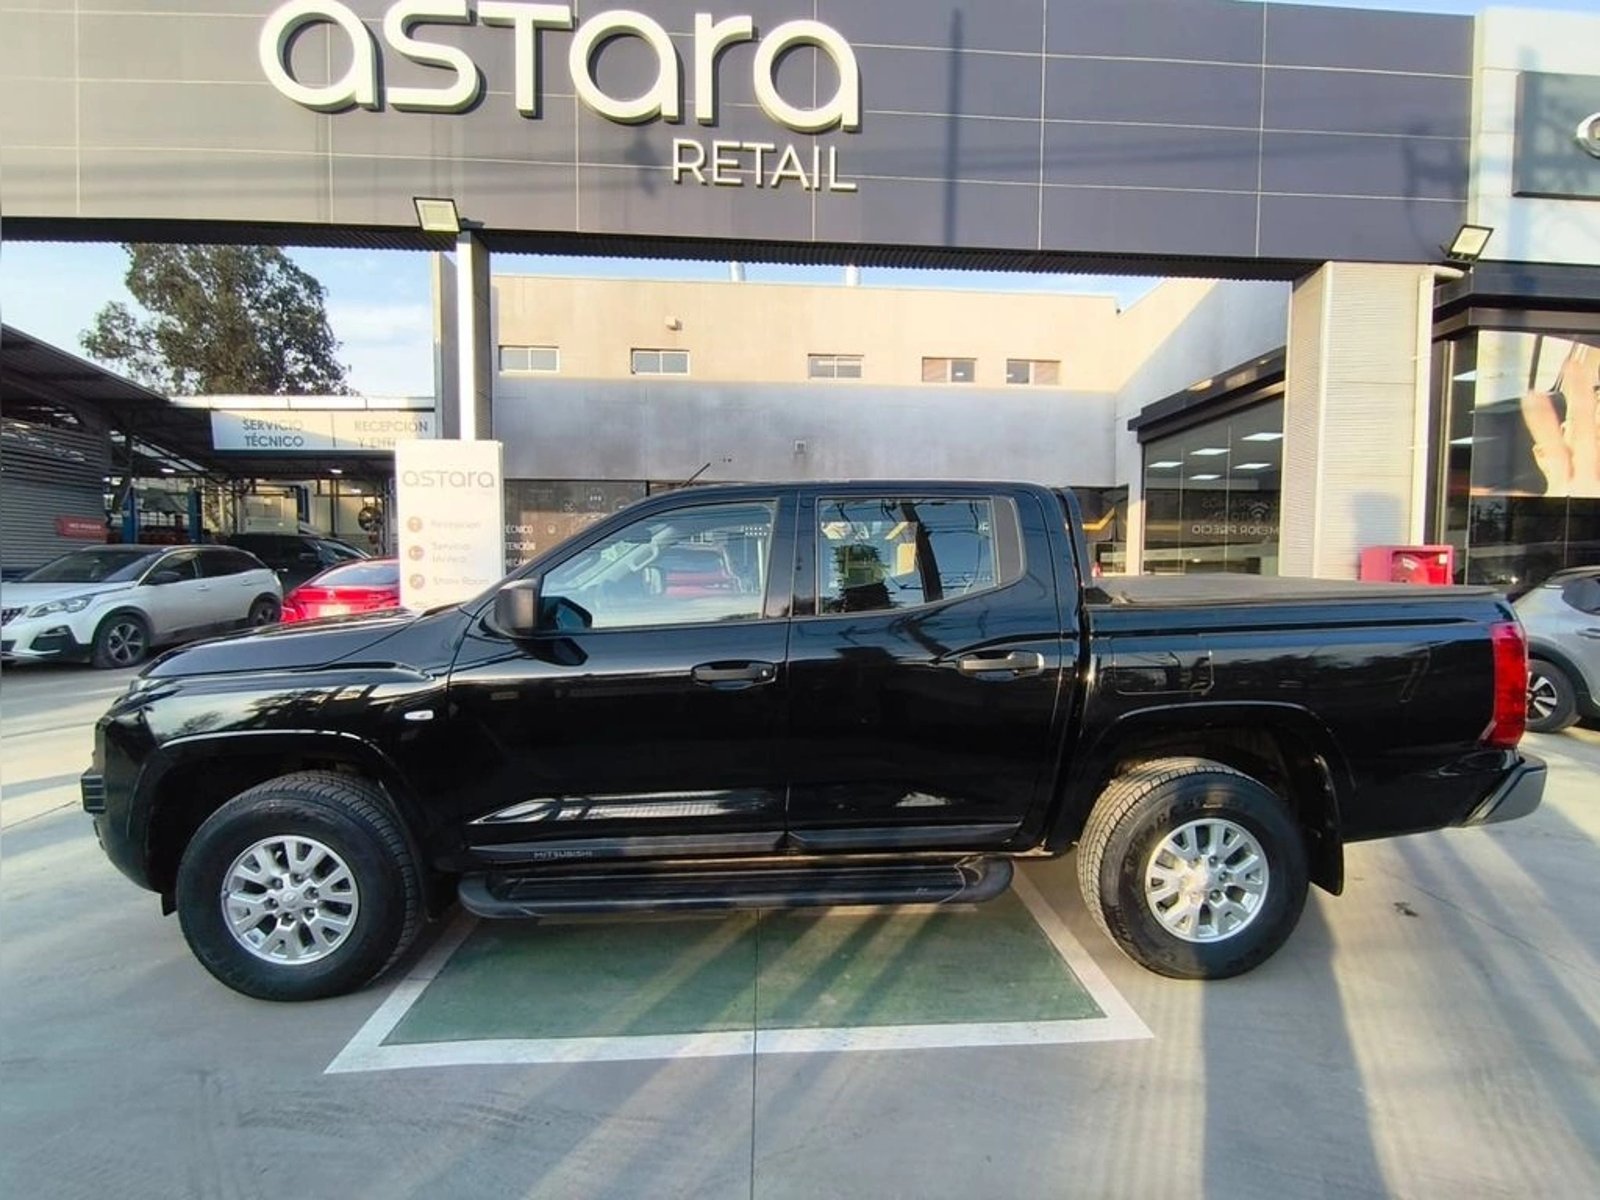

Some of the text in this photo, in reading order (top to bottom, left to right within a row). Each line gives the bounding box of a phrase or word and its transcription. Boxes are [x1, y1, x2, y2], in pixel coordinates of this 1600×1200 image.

[672, 137, 858, 192] RETAIL
[242, 418, 303, 431] SERVICIO
[244, 433, 304, 447] TÉCNICO
[402, 470, 495, 488] astara
